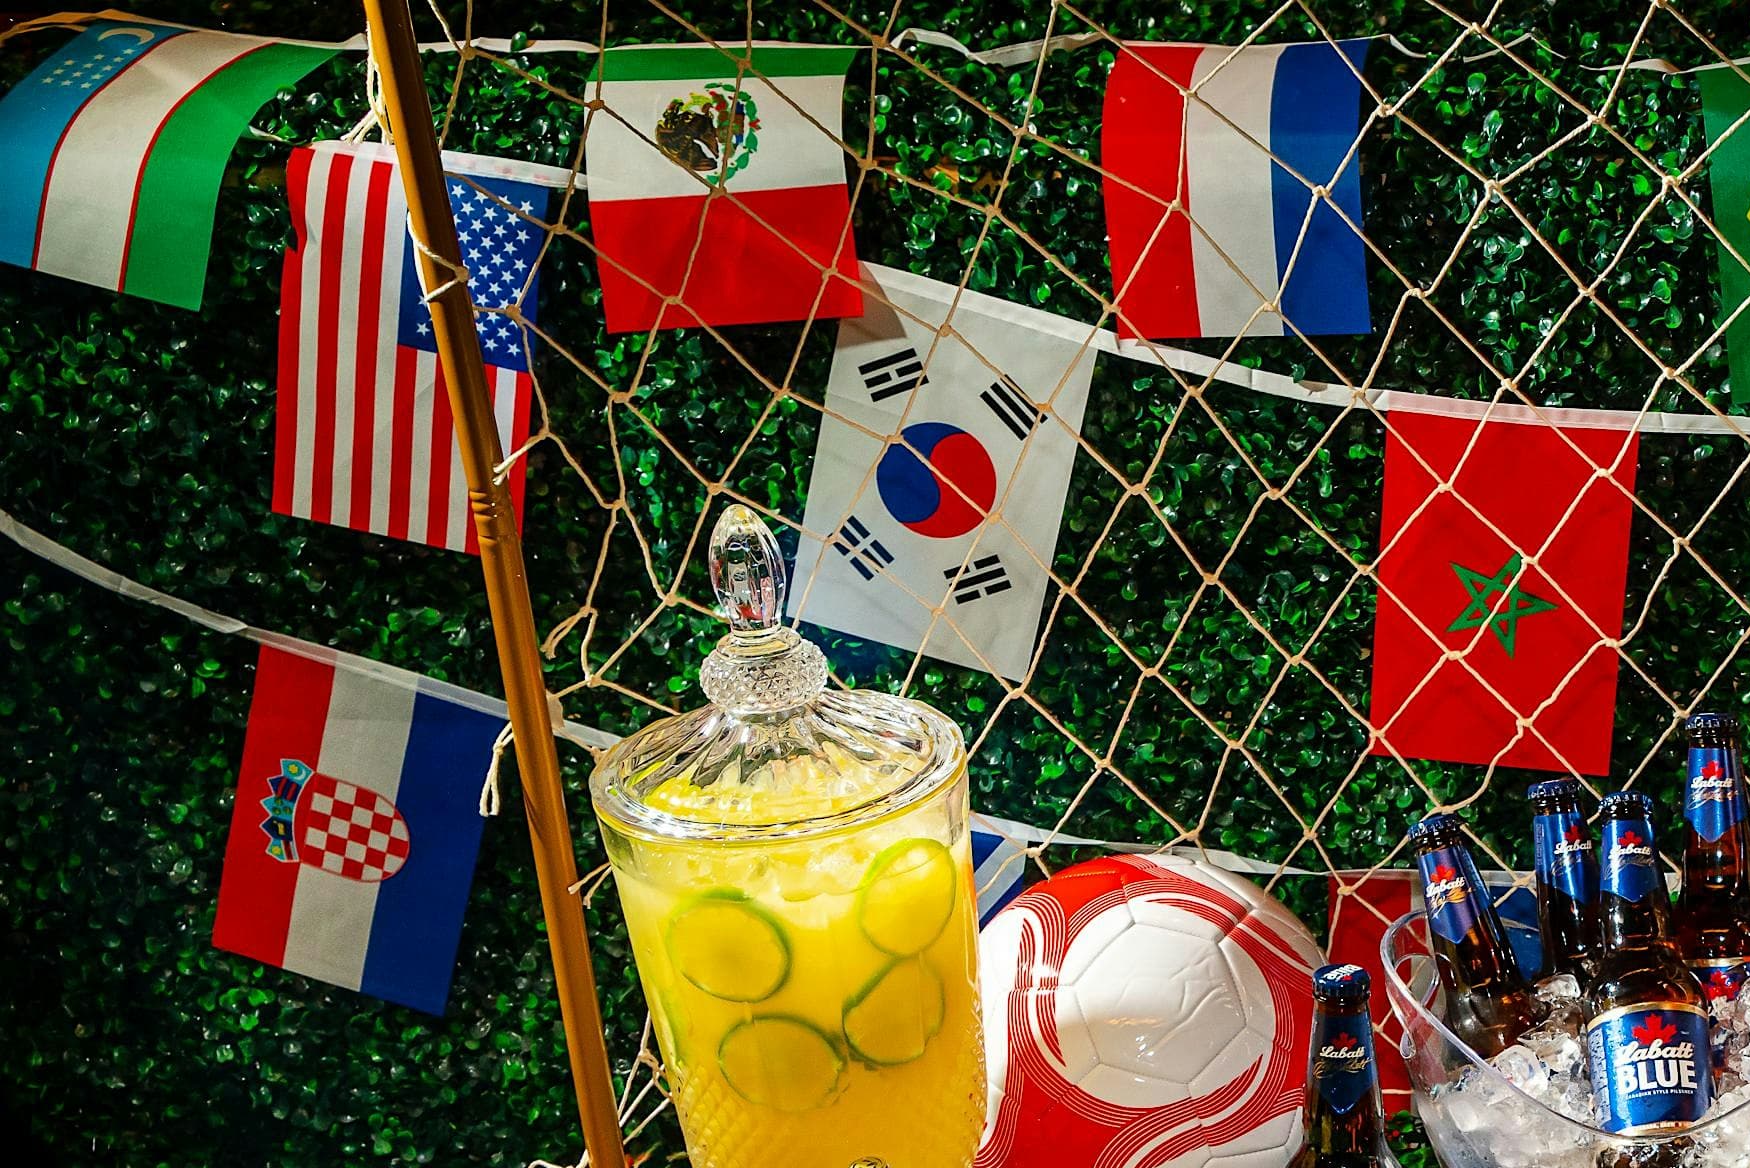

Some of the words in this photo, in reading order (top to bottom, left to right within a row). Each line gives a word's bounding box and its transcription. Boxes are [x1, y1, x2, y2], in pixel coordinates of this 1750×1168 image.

[1691, 776, 1734, 788] Labatt
[1426, 876, 1465, 898] Labatt
[1319, 1045, 1365, 1059] Labatt
[1615, 1038, 1695, 1067] Labatt
[1616, 1059, 1698, 1095] BLUE
